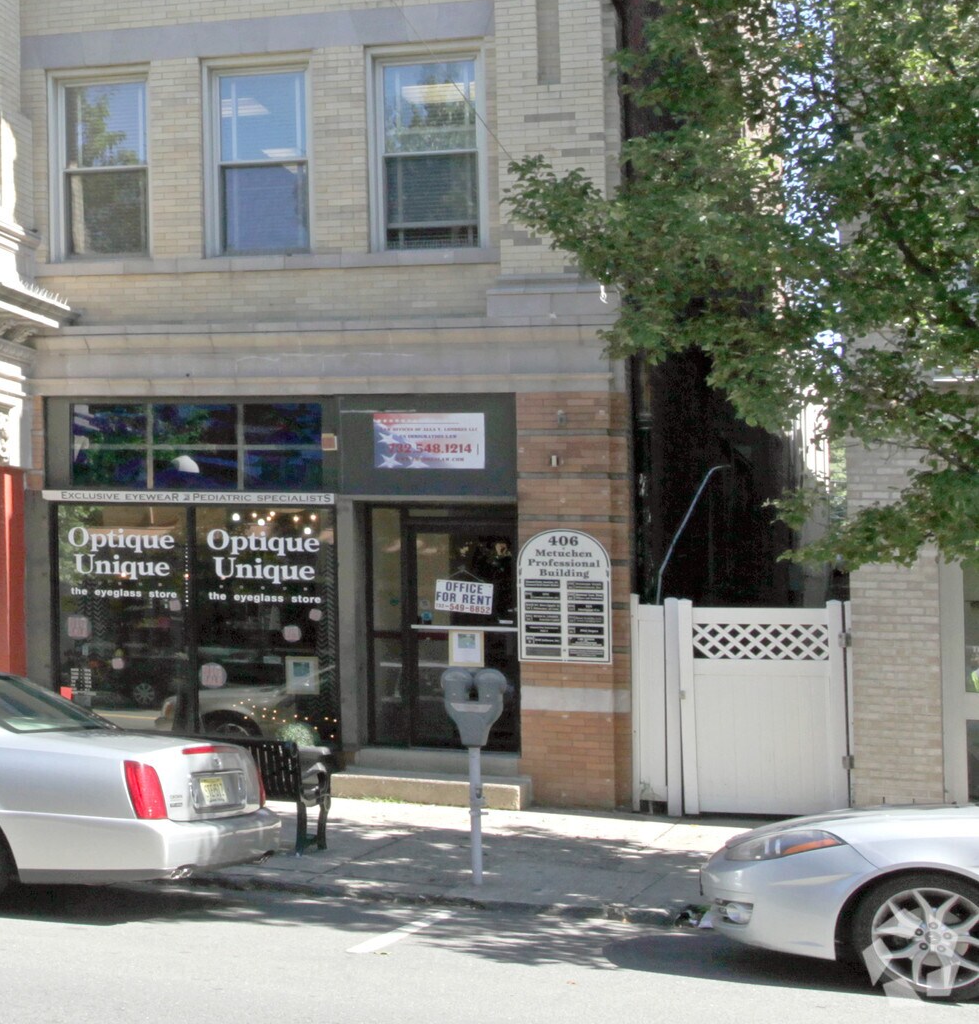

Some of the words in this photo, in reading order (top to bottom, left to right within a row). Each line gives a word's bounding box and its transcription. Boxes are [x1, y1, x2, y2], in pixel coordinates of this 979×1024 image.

[62, 491, 120, 501] EXCLUSIVE
[125, 492, 179, 501] EYEWEAR
[192, 493, 252, 502] PEDIATRIC
[256, 494, 332, 503] SPECIALISTS
[68, 526, 175, 553] Optique
[206, 529, 320, 556] Optique
[548, 536, 579, 546] 406
[535, 549, 593, 557] Metuchen
[74, 553, 171, 580] Unique
[528, 558, 600, 568] Professional
[212, 557, 316, 584] Unique
[539, 569, 590, 579] Building
[70, 587, 88, 596] the
[94, 588, 142, 599] eyeglass
[149, 590, 178, 599] store
[445, 581, 483, 594] OFFICE
[208, 591, 227, 601] the
[233, 593, 284, 604] eyeglass
[291, 594, 322, 604] store
[436, 591, 457, 603] FOR
[462, 593, 492, 606] RENT
